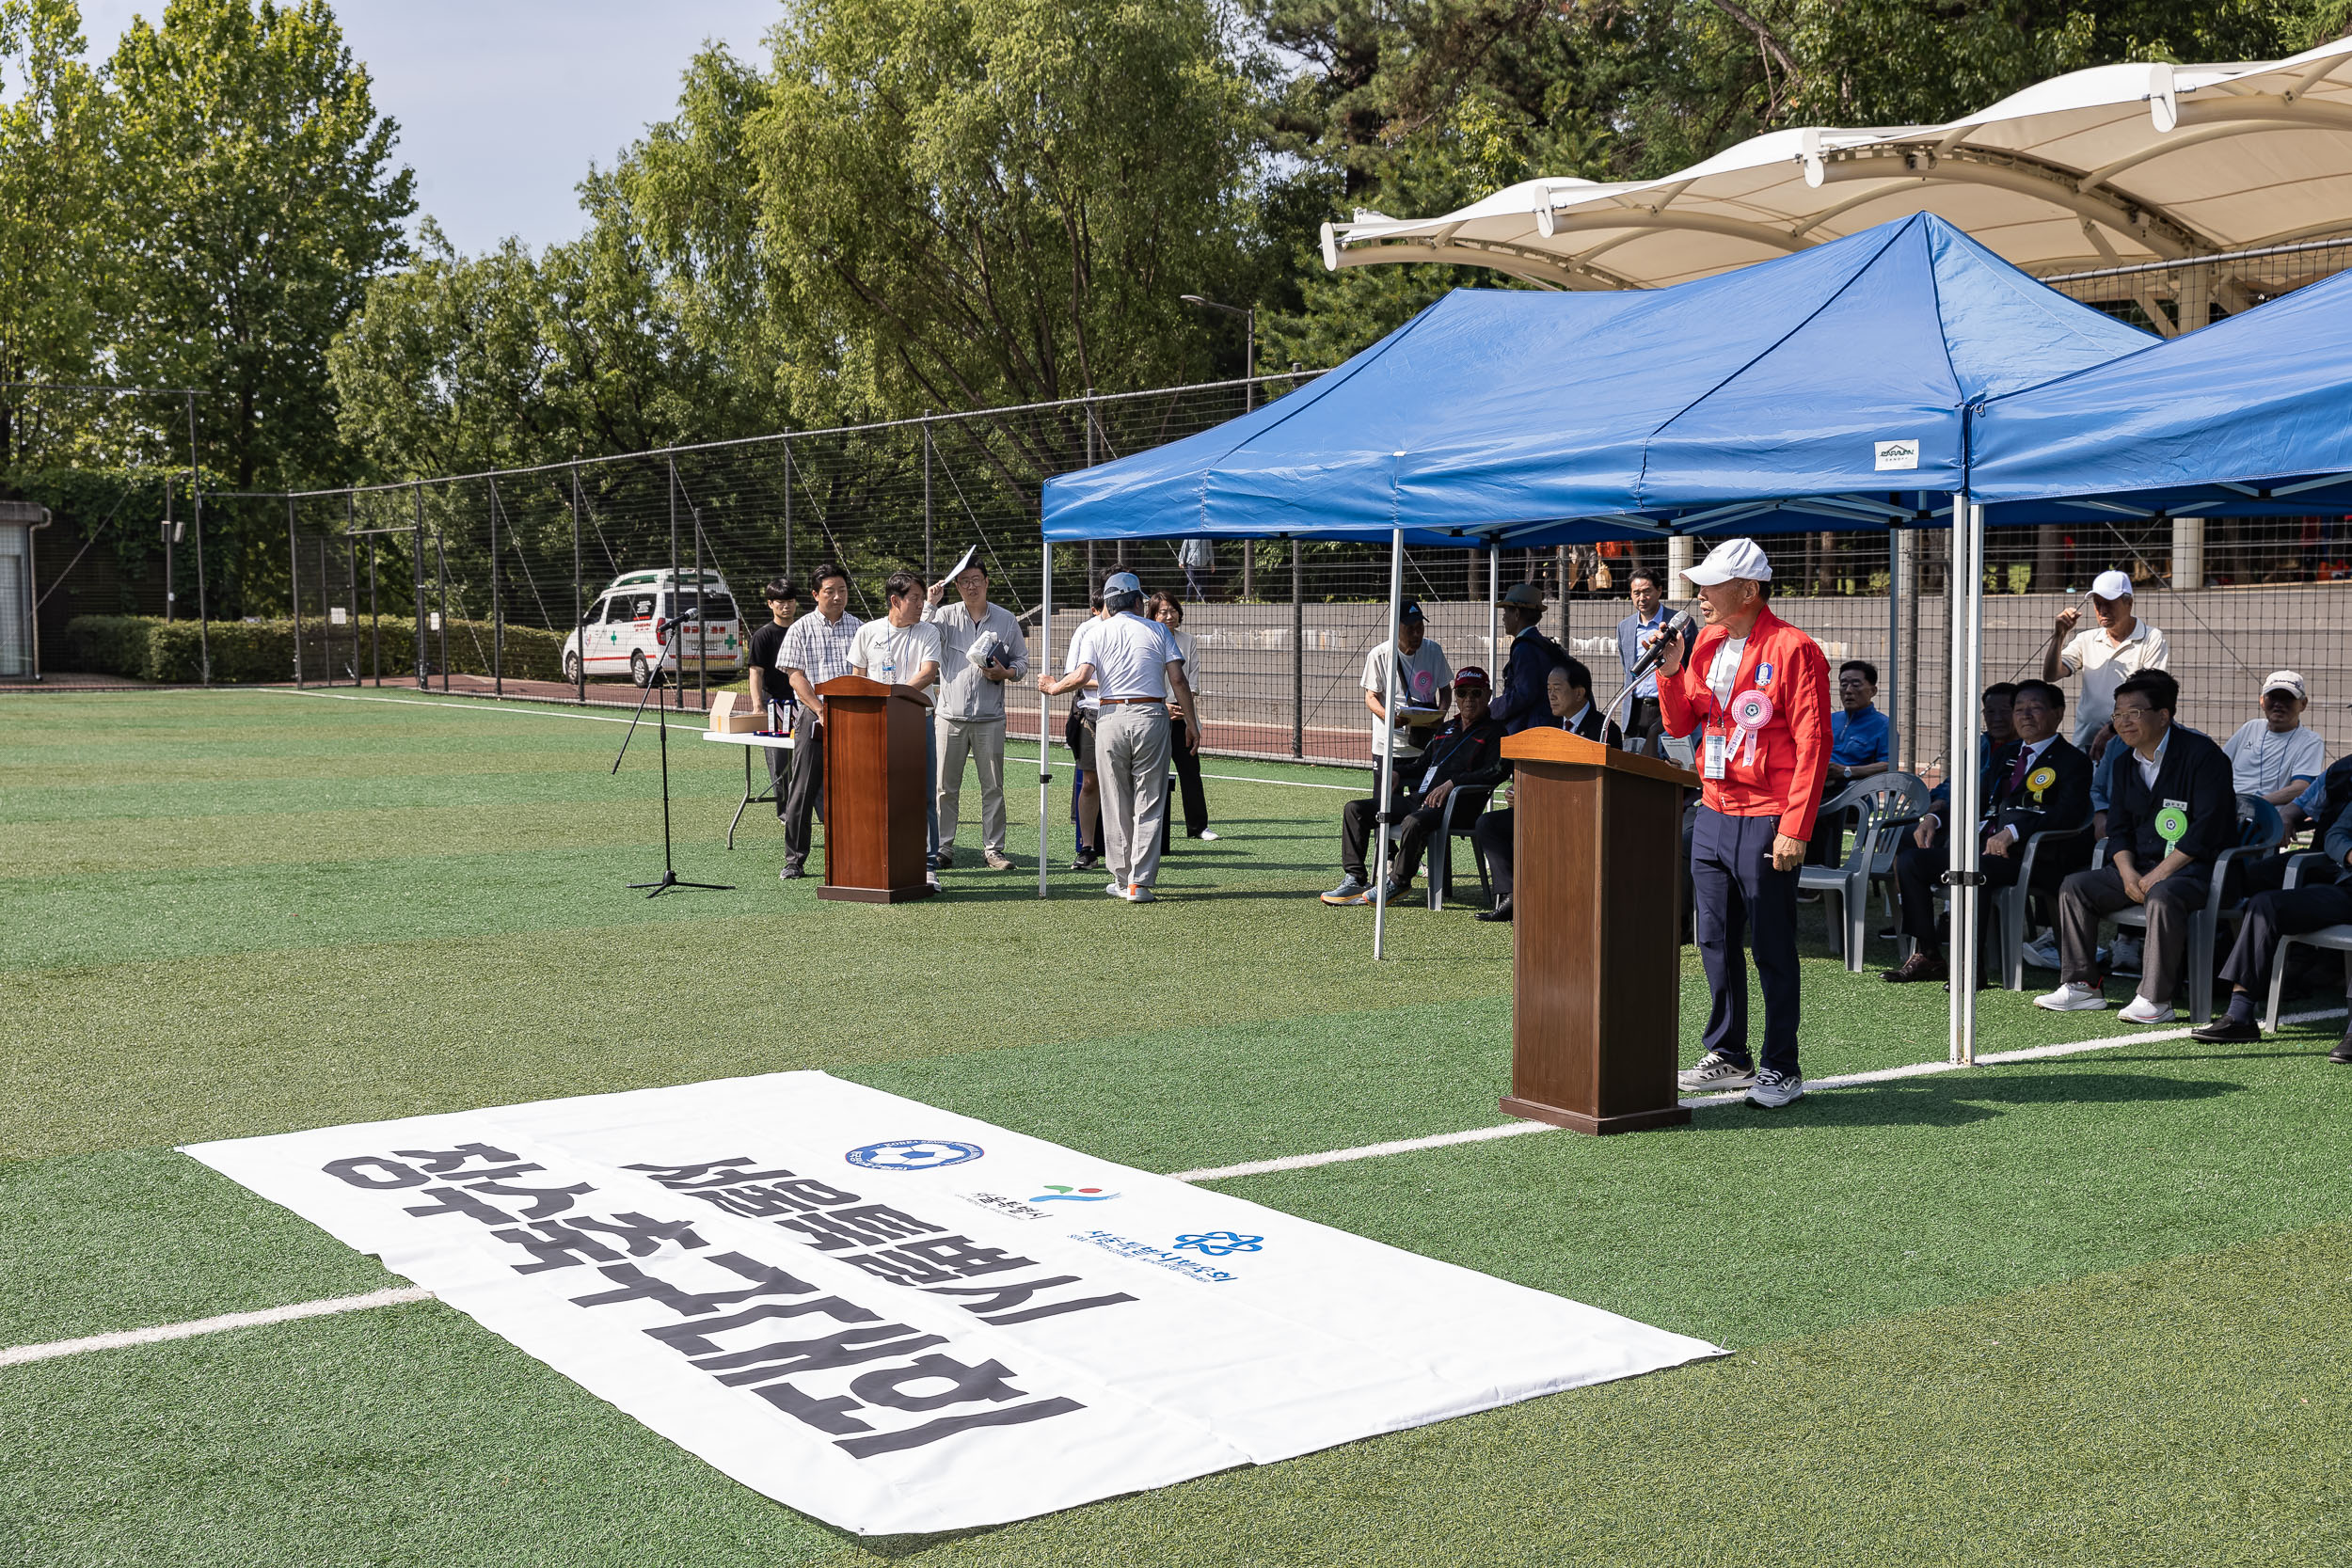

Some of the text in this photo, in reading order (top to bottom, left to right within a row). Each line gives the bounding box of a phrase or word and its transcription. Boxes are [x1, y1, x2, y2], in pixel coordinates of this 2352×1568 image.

[620, 1157, 1140, 1326] 서울특별시
[971, 1192, 1054, 1220] 서울특별시
[1085, 1230, 1239, 1282] 서울특별시체육회
[322, 1143, 1089, 1460] 장수축구대회
